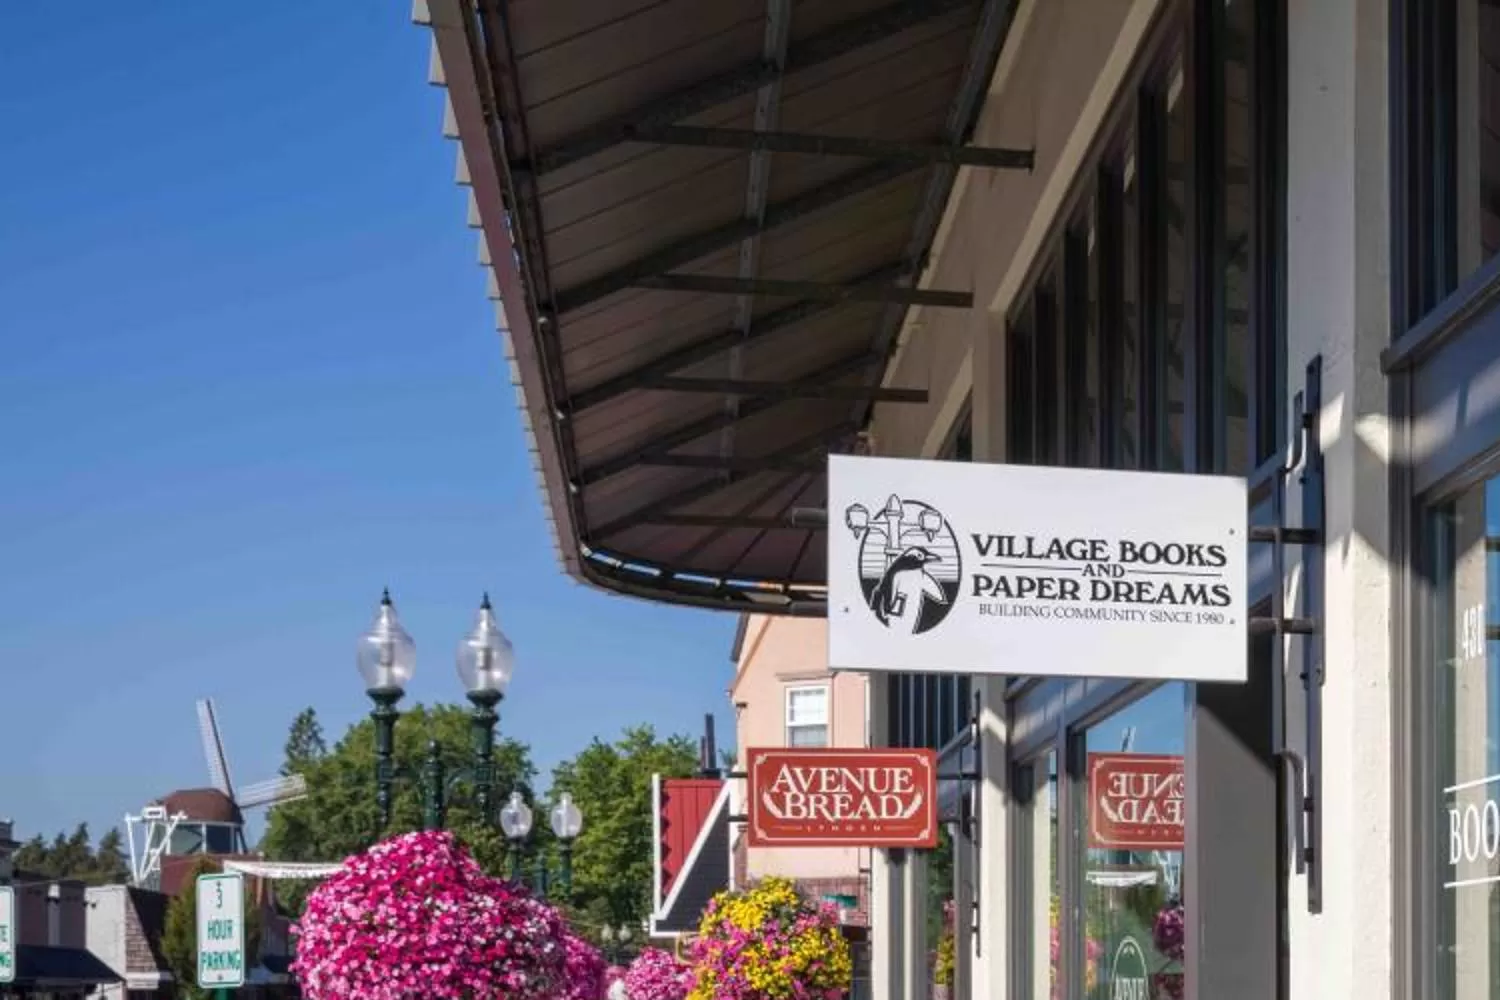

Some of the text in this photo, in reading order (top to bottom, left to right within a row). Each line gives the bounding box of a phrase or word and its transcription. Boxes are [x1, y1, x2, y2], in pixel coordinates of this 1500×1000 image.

[971, 534, 1227, 567] VILLAGE BOOKS
[1081, 563, 1125, 578] AND
[972, 574, 1232, 607] PAPER DREAMS
[979, 604, 1225, 625] BUILDING COMMUNITY SINCE 1980
[770, 763, 915, 794] AVENUE
[781, 791, 905, 822] BREAD
[207, 919, 234, 941] HOUR
[200, 950, 241, 970] PARKING
